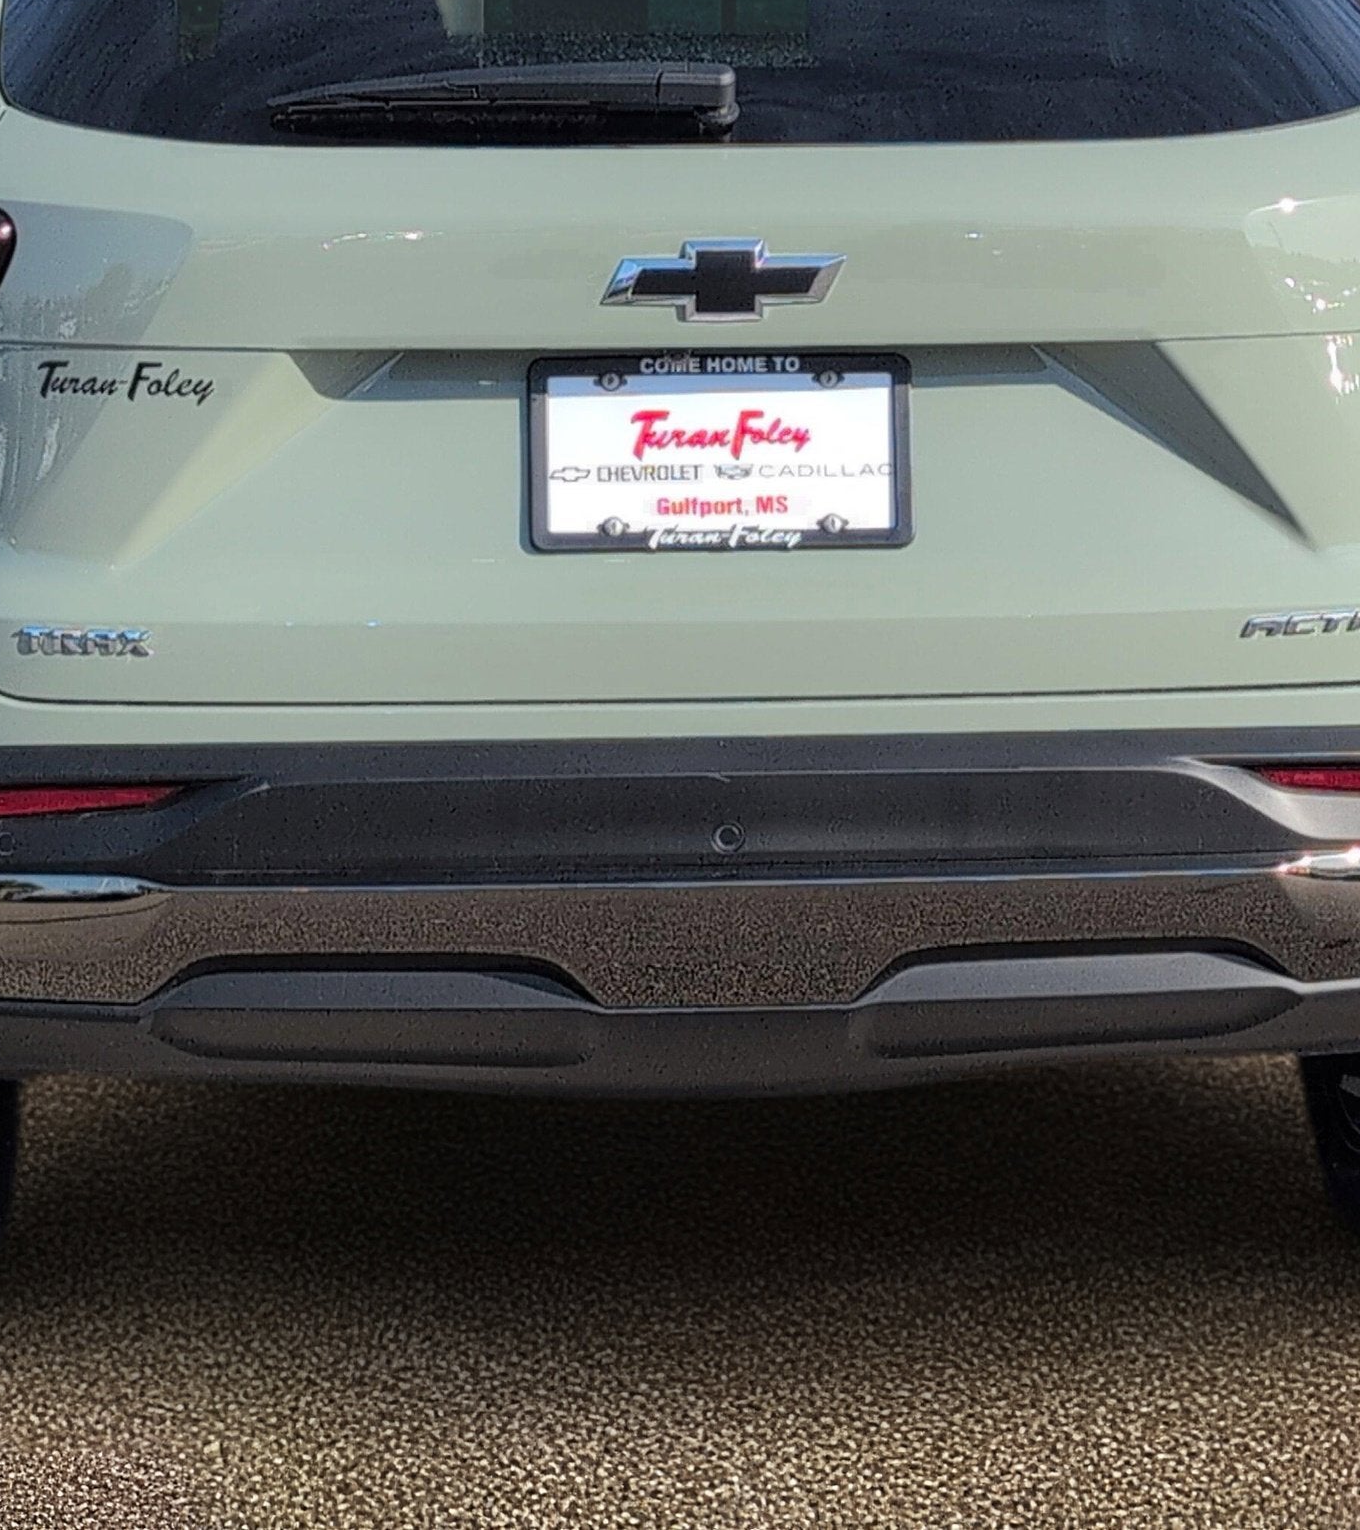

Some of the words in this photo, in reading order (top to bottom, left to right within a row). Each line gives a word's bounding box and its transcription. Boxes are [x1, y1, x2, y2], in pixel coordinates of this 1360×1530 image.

[706, 355, 768, 373] HOME
[772, 355, 800, 372] TO
[730, 410, 811, 461] Foley
[596, 464, 702, 482] CHEVROLET
[758, 463, 893, 478] CADILLAC
[656, 497, 749, 518] Gulfport,
[755, 496, 788, 514] MS
